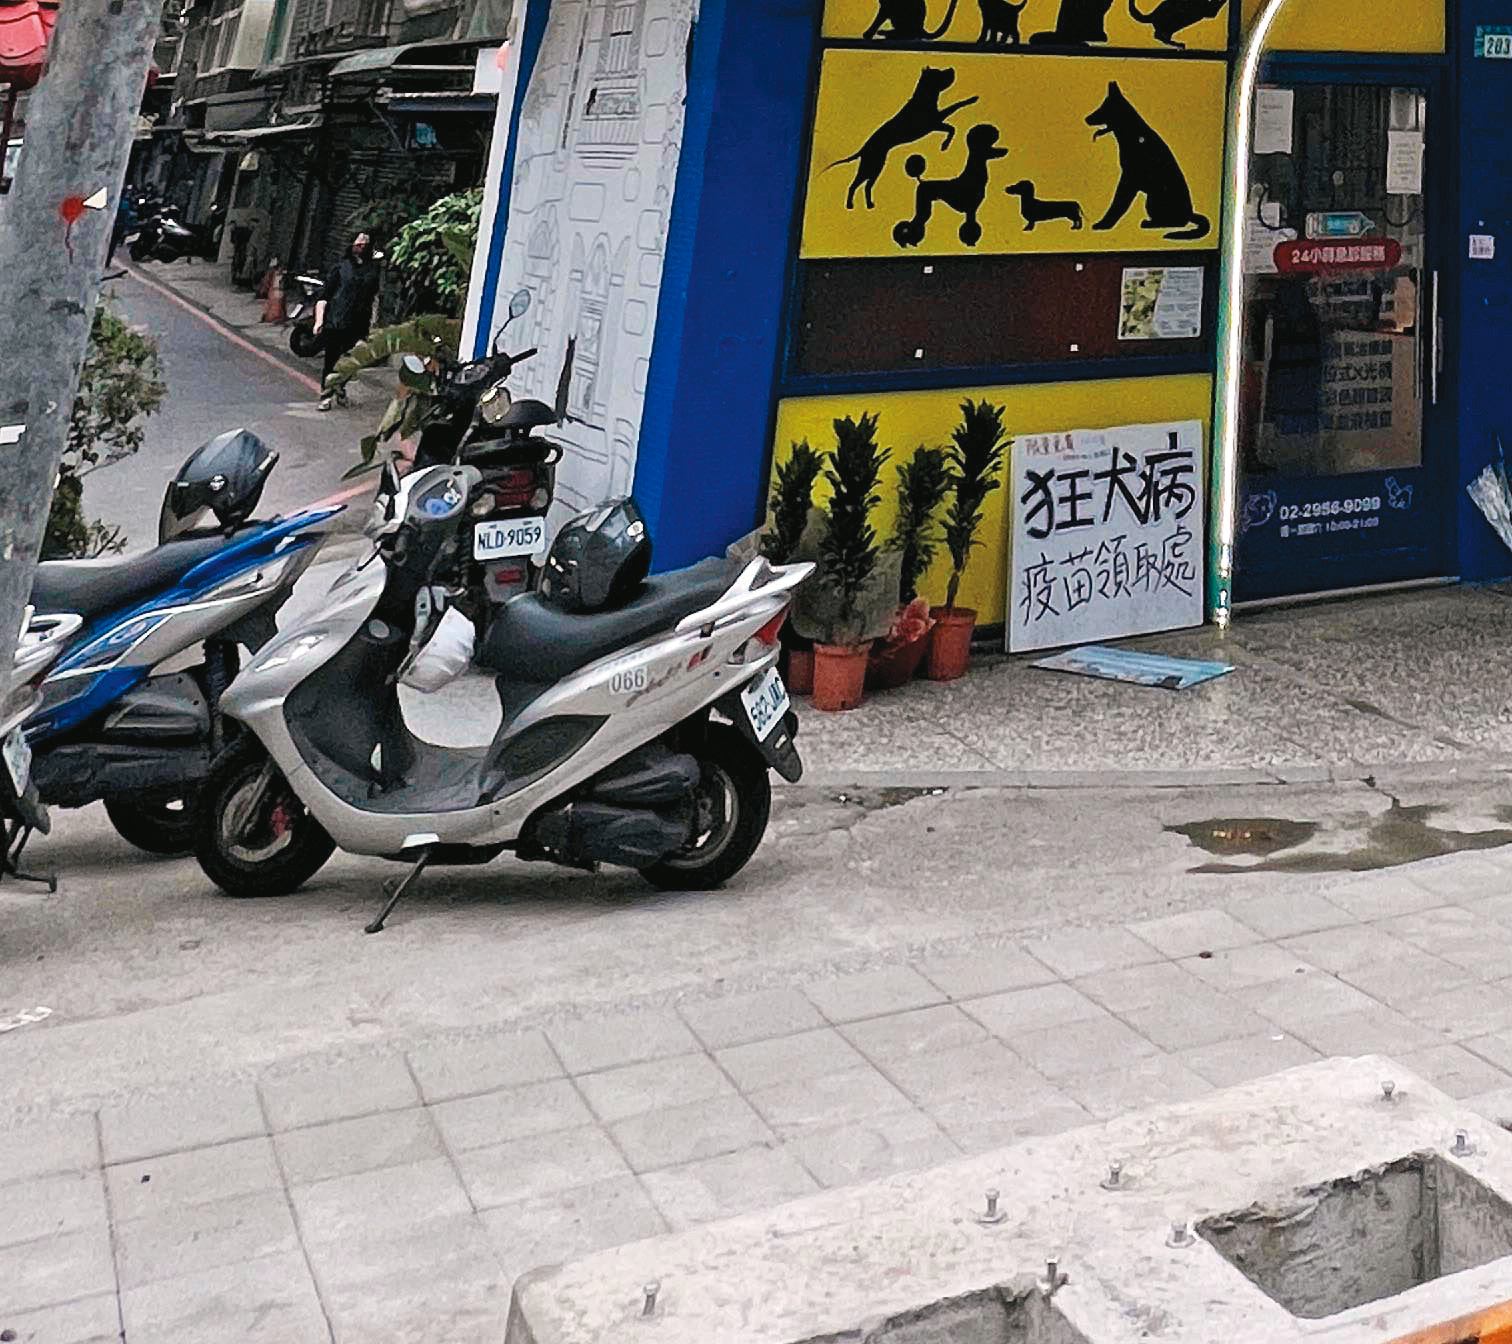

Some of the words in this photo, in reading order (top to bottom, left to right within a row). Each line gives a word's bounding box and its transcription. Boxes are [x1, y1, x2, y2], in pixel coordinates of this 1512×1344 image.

[1021, 432, 1195, 539] 狂犬病
[1020, 526, 1195, 626] 疫苗領取處
[611, 668, 644, 693] 066
